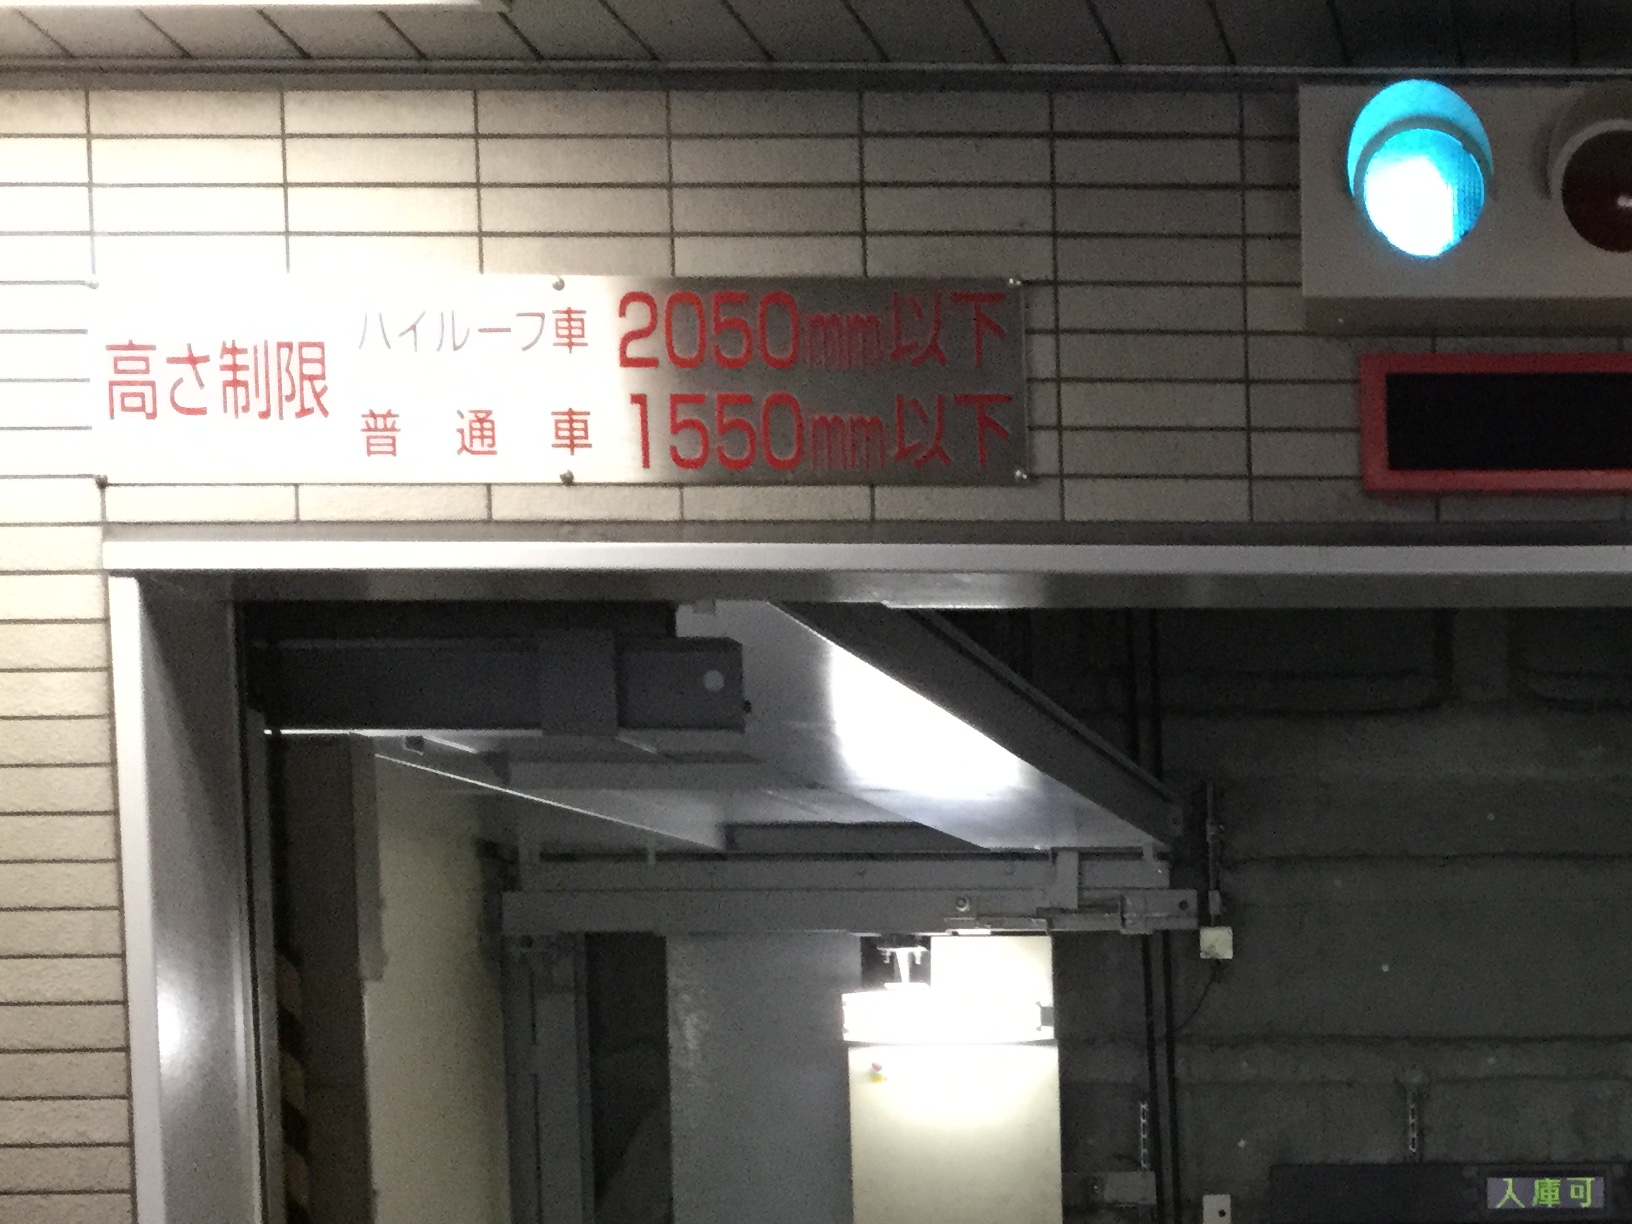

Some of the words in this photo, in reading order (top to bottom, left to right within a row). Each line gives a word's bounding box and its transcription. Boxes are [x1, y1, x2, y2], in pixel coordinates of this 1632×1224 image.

[357, 305, 588, 354] ハイルーフ車
[617, 289, 1009, 371] 2050mm以下
[104, 339, 330, 421] 高さ制限
[359, 408, 593, 458] 普通車
[629, 391, 1013, 471] 1550mm以下
[1495, 1176, 1597, 1209] 入庫可
